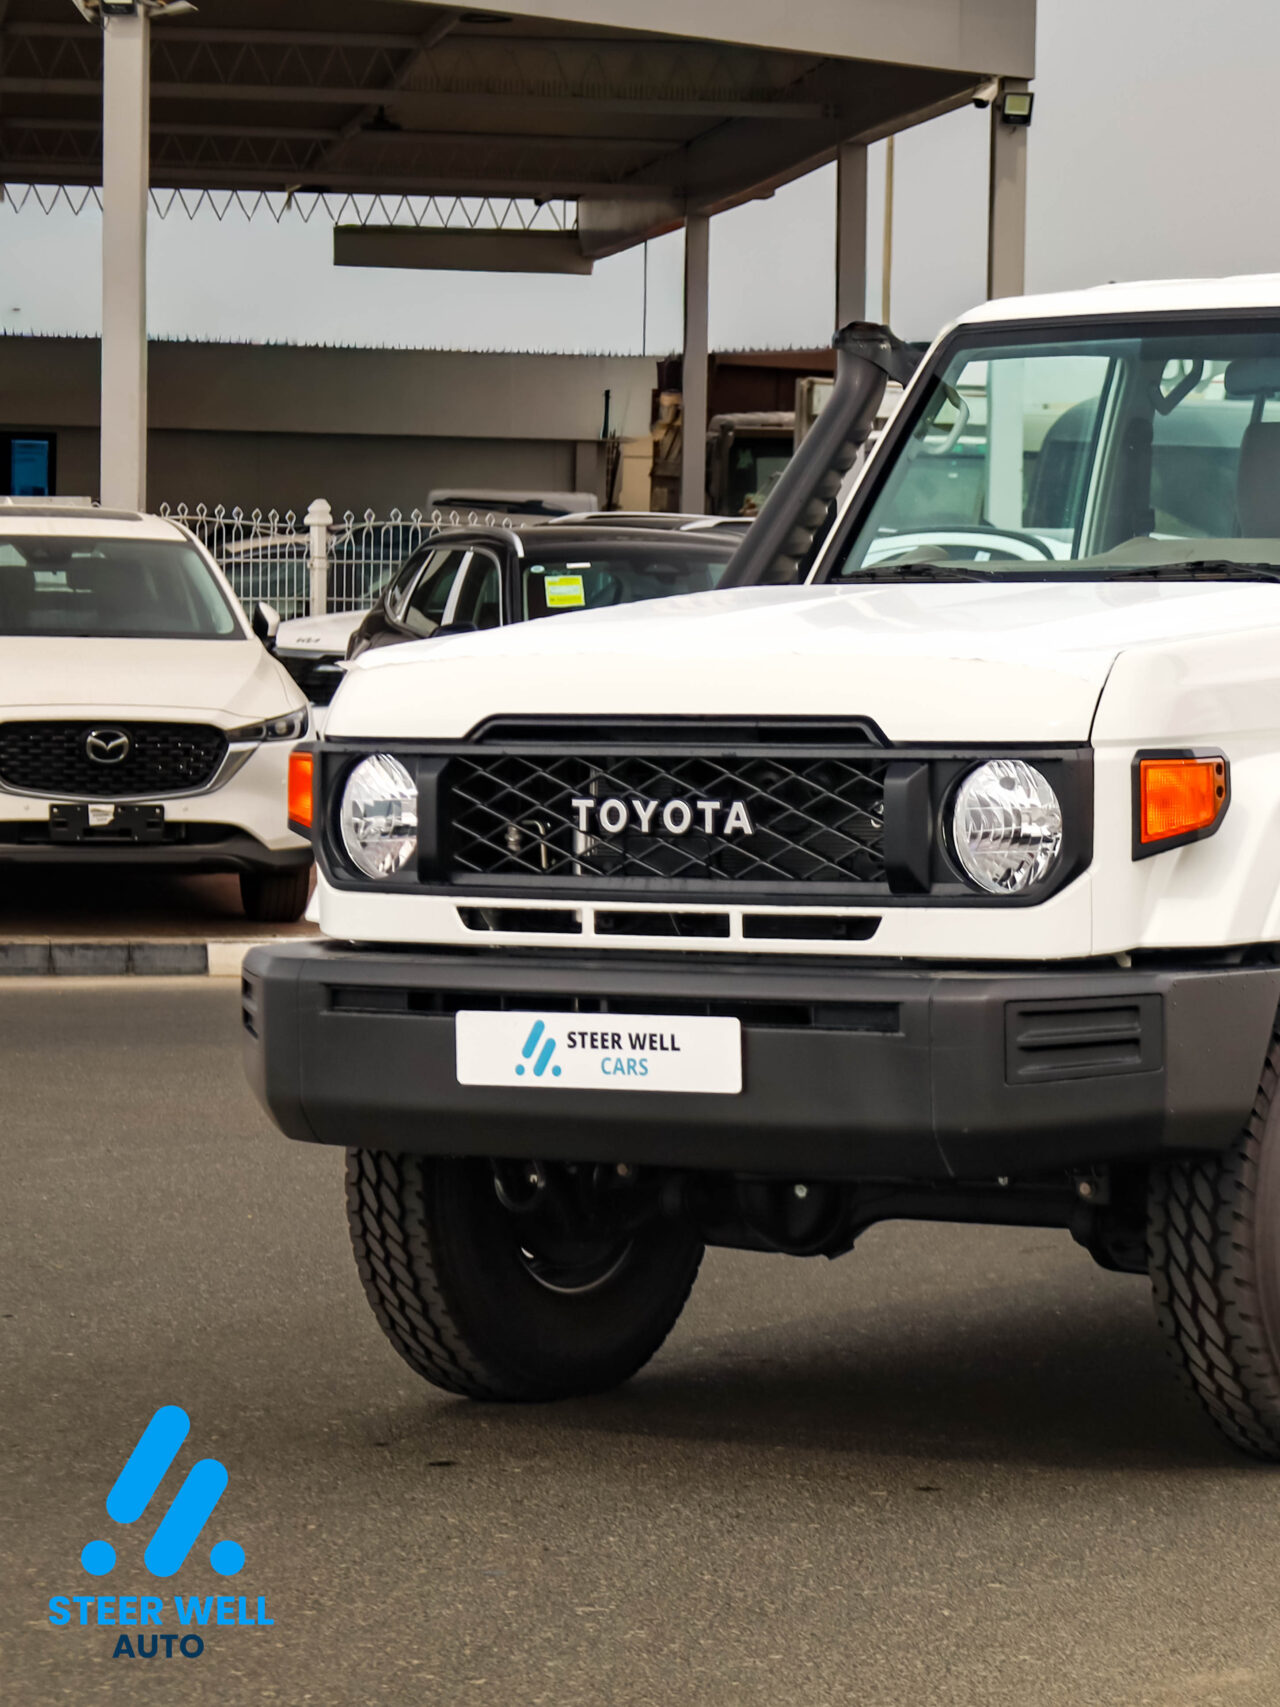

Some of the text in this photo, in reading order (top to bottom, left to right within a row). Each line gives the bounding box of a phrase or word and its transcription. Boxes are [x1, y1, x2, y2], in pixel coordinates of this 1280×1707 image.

[571, 798, 753, 834] TOYOTA
[567, 1031, 680, 1051] STEER WELL
[600, 1057, 648, 1076] CARS
